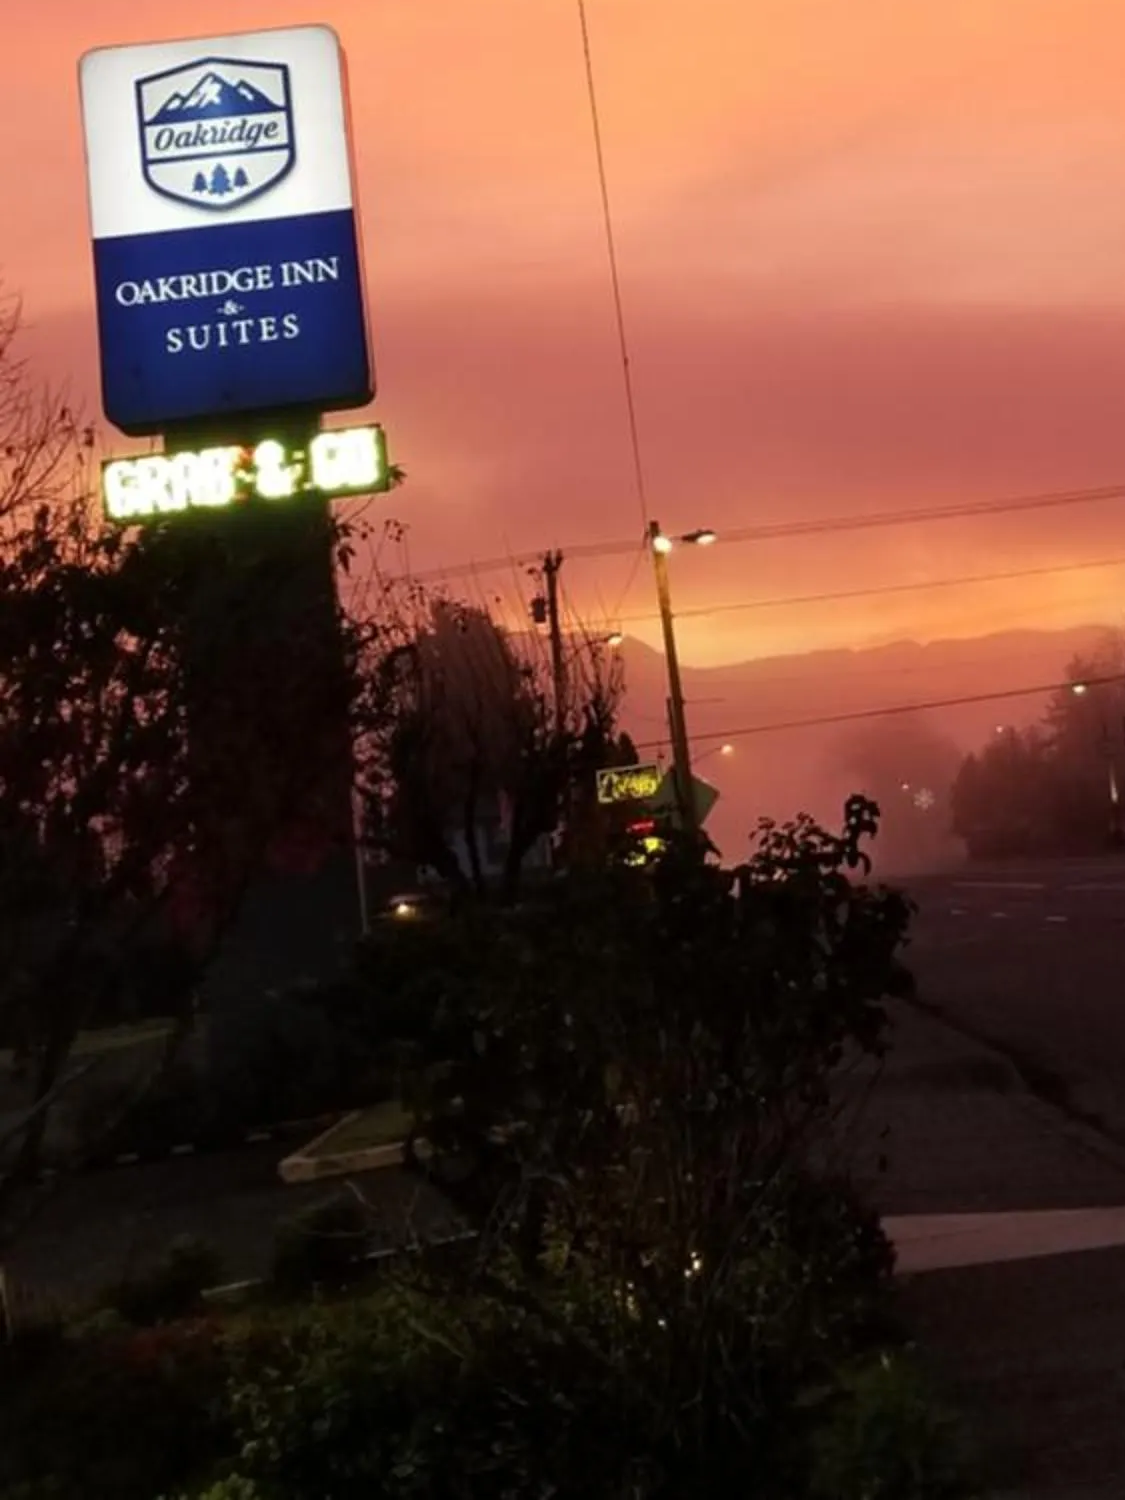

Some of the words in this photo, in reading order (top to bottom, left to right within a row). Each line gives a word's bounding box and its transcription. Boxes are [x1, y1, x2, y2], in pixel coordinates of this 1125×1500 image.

[154, 118, 279, 151] Oakridge
[115, 264, 275, 307] OAKRIDGE
[280, 256, 339, 287] INN
[166, 312, 300, 354] SUITES
